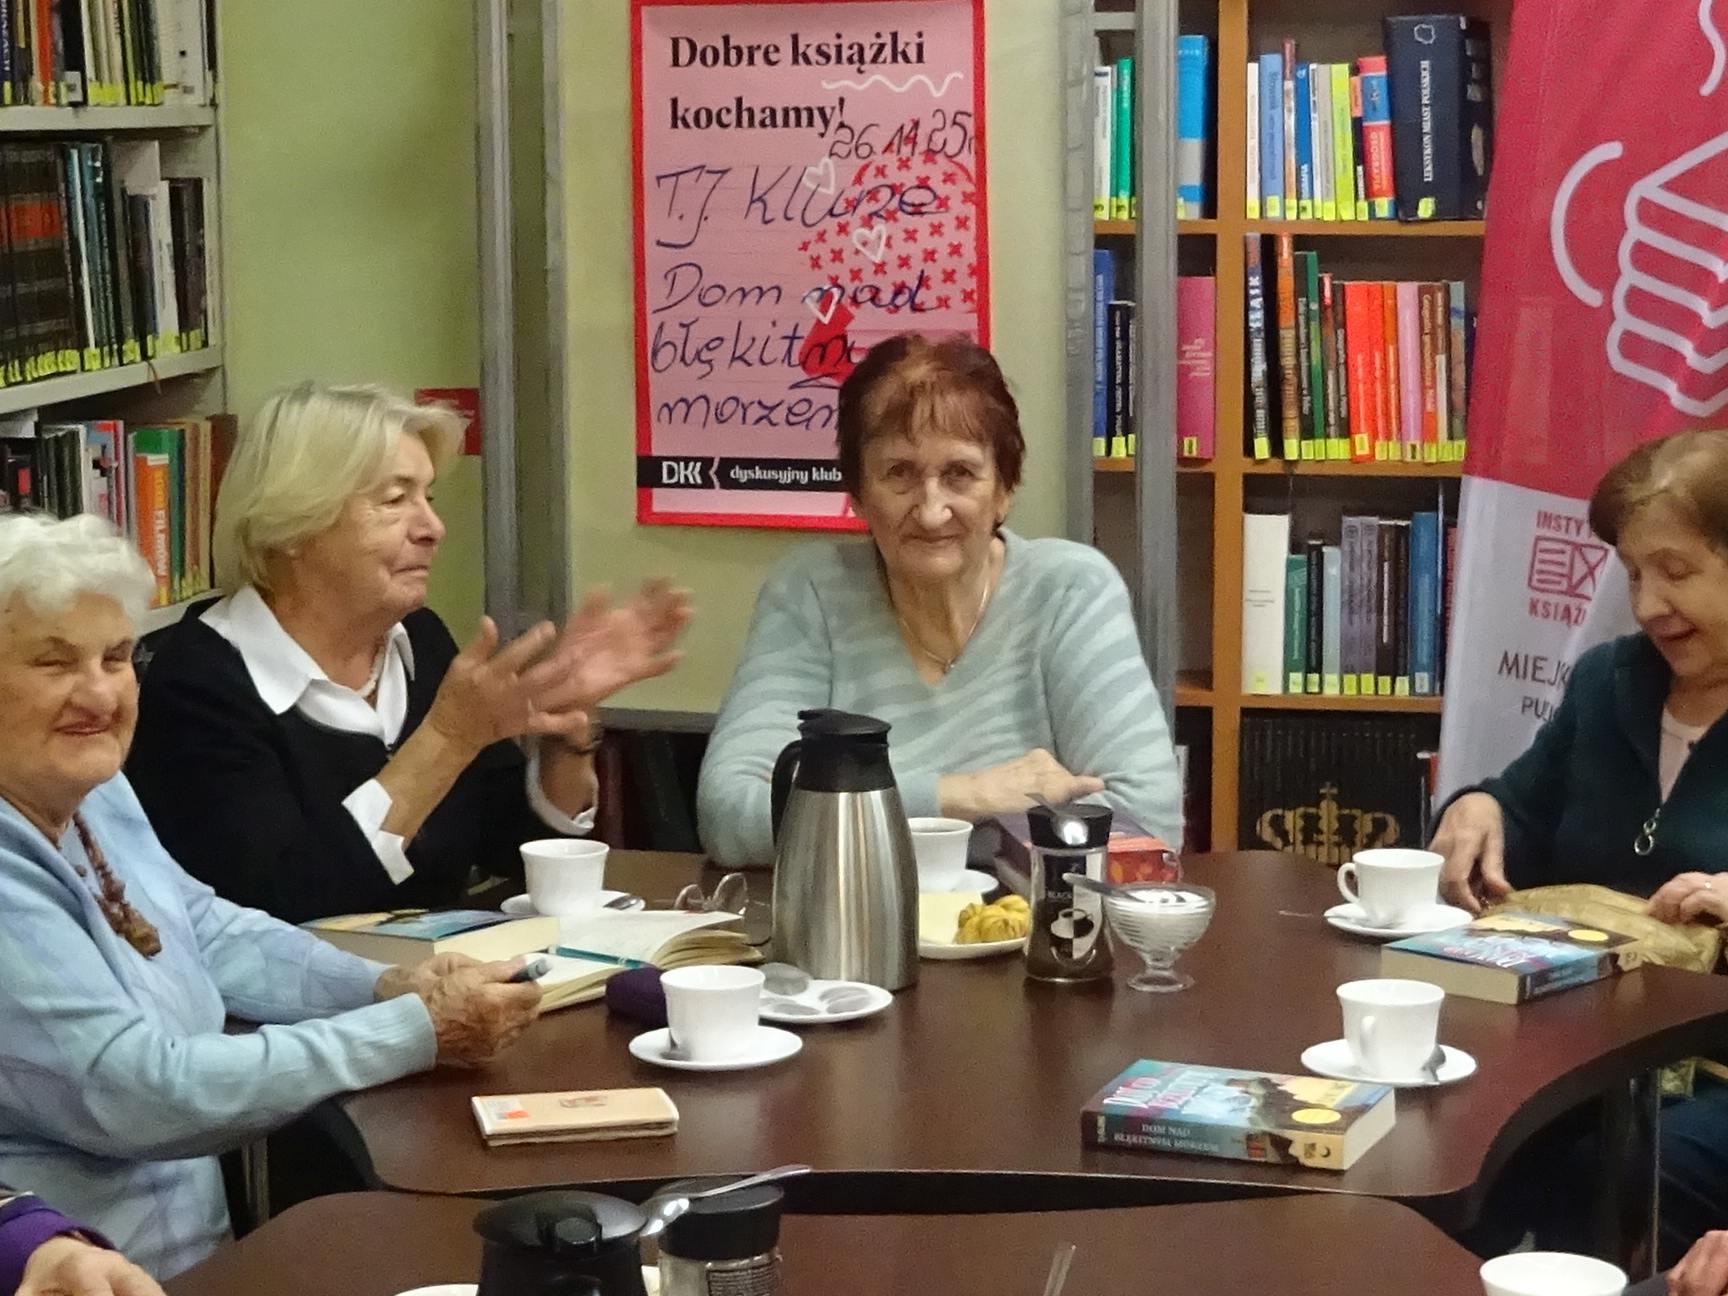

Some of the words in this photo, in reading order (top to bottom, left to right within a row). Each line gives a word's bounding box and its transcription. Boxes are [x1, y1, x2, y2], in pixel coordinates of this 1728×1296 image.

[670, 34, 781, 70] Dobre
[790, 30, 926, 74] książki
[670, 95, 846, 138] kochamy!
[1422, 135, 1432, 182] LEKSYKON
[652, 262, 781, 314] Dom
[805, 270, 937, 312] nad
[661, 460, 703, 485] DKK
[729, 465, 809, 484] dyskusyjny
[812, 465, 842, 482] klub
